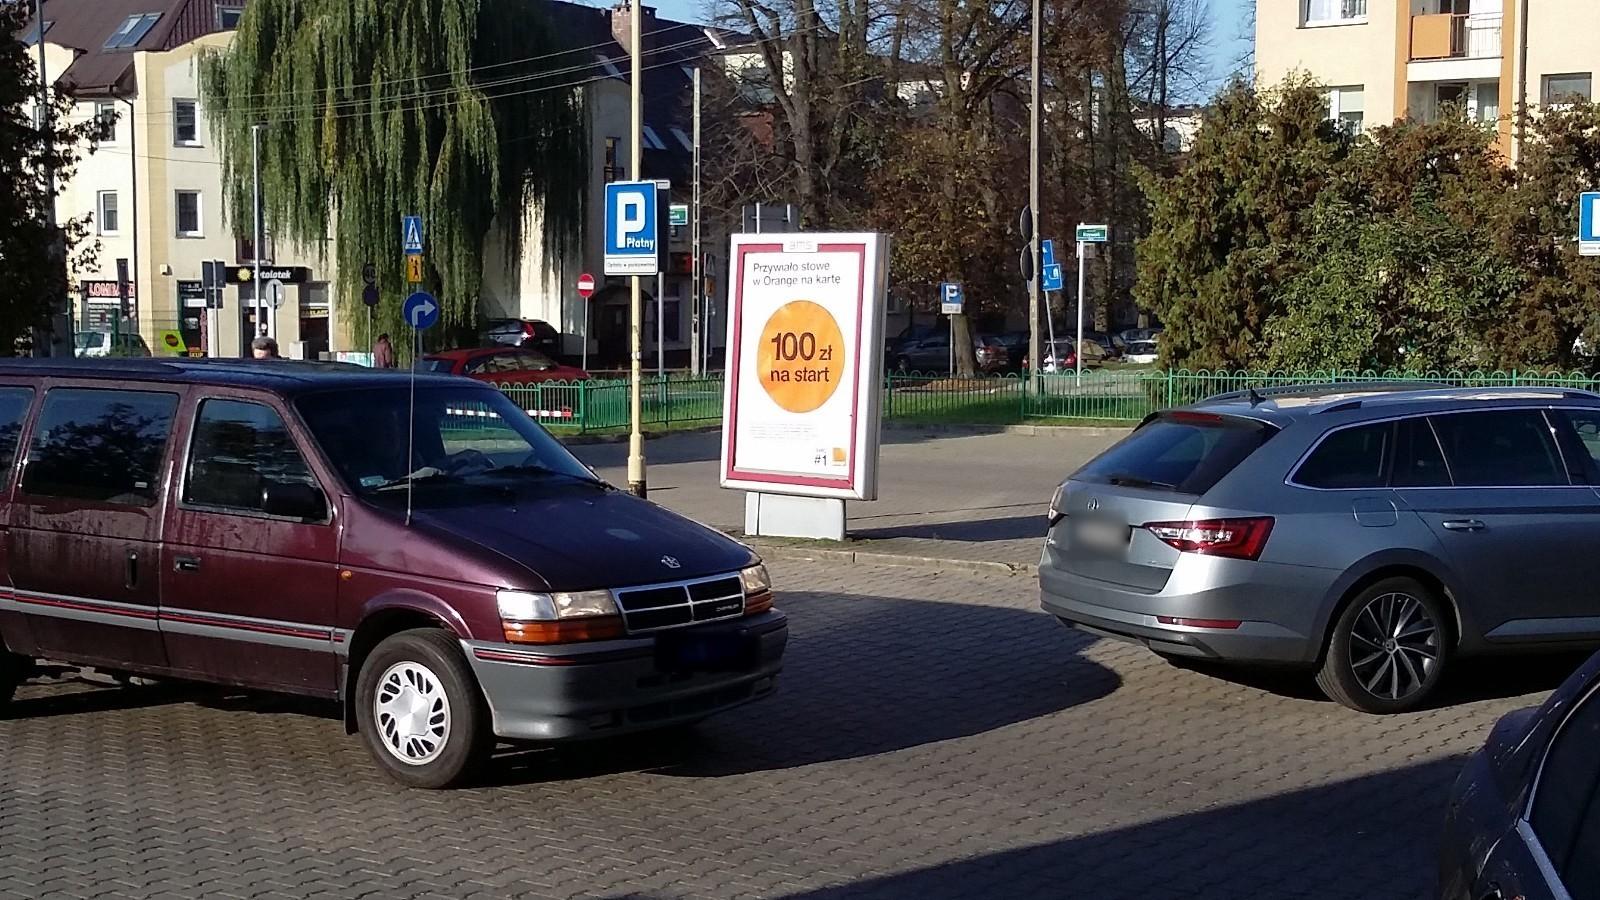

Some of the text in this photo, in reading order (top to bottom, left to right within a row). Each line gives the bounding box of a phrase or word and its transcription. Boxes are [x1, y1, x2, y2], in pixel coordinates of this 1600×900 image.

[616, 192, 645, 248] P
[627, 237, 654, 251] Płatny
[252, 269, 291, 279] Ttolotek
[763, 275, 798, 287] Orange
[89, 282, 134, 296] LOMBD
[945, 285, 958, 302] P
[771, 332, 832, 361] 100 zł
[770, 366, 830, 382] na start
